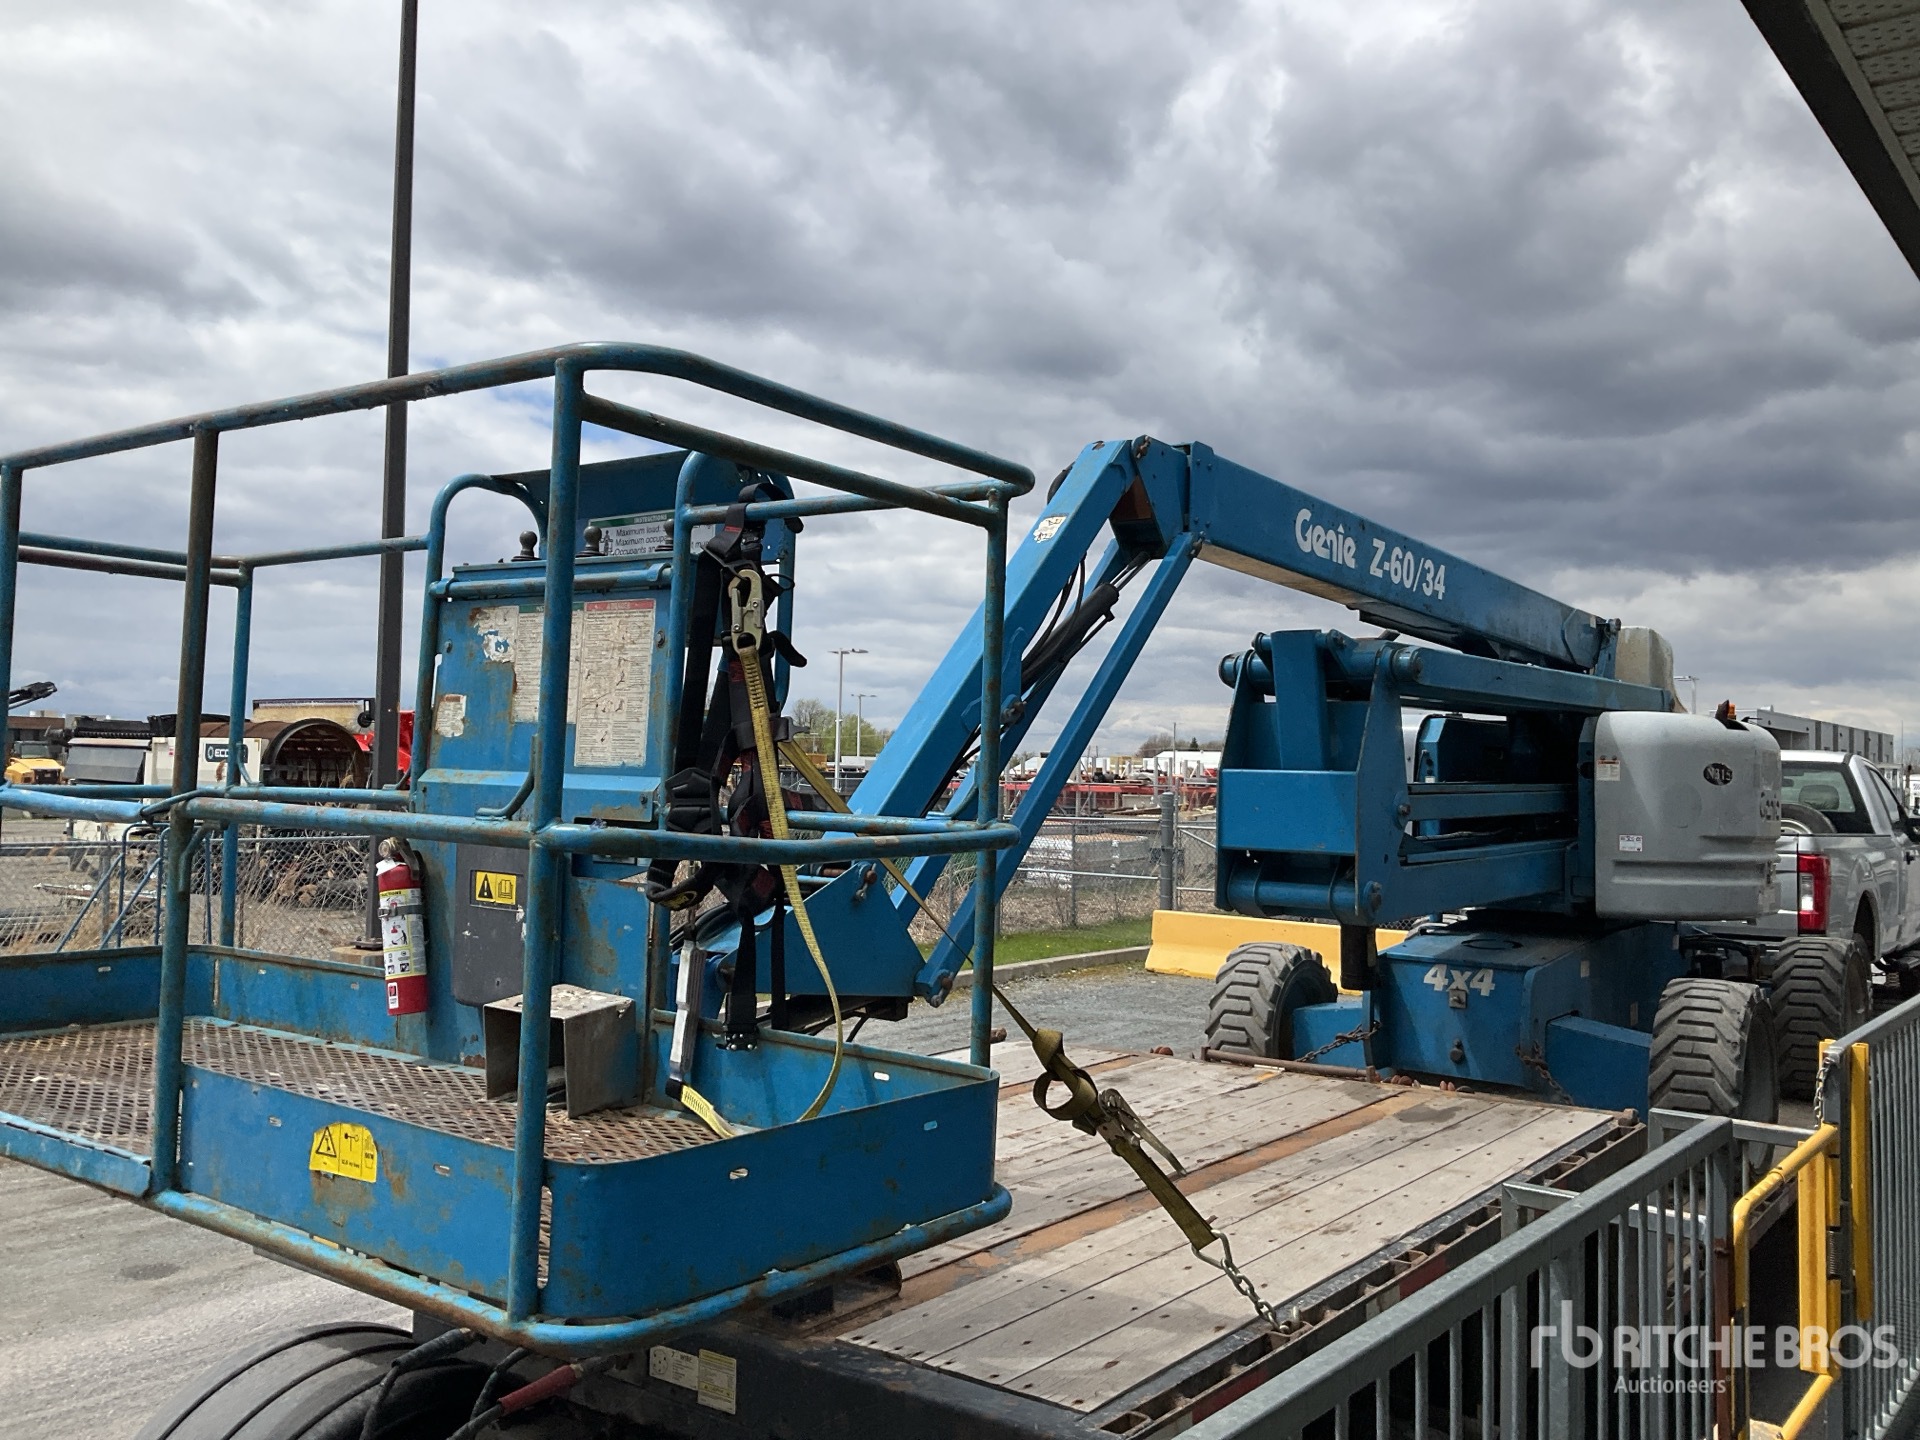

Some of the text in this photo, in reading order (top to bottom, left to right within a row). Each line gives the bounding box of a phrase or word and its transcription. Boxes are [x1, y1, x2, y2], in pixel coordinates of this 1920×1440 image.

[615, 537, 645, 546] Maximum
[616, 527, 645, 537] Maximum
[1295, 508, 1446, 600] Genie Z-60/34
[1423, 963, 1495, 997] 4x4
